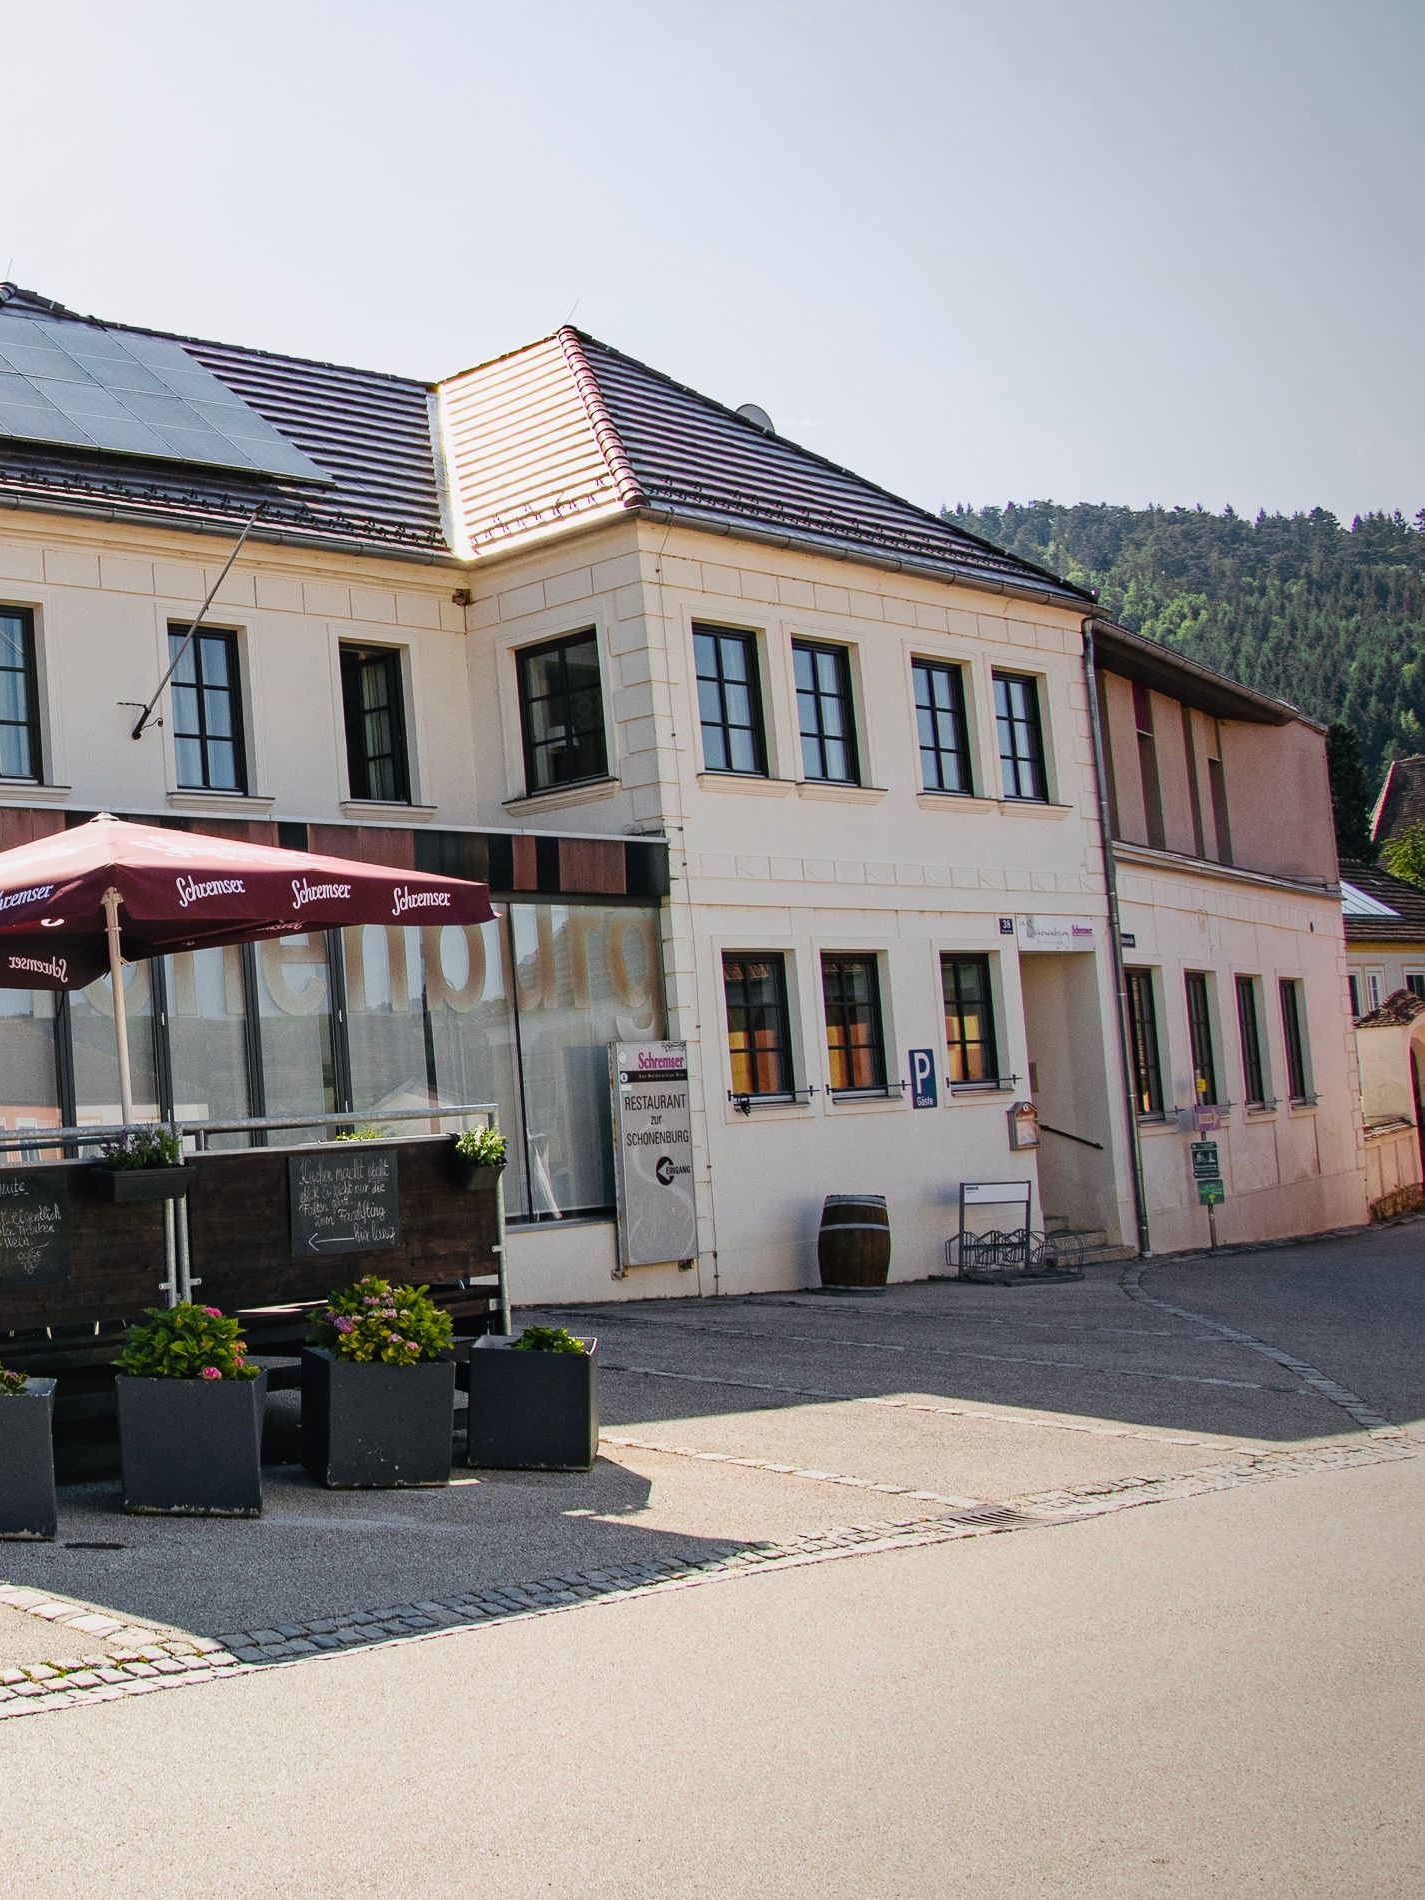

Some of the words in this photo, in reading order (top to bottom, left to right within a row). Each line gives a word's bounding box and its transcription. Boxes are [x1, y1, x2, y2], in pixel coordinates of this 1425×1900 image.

[175, 875, 246, 908] Schremser
[291, 877, 351, 910] Schremser
[391, 887, 451, 917] Schremser
[638, 1051, 684, 1069] Schremser
[914, 1052, 930, 1094] P
[624, 1093, 687, 1111] RESTAURANT
[650, 1115, 663, 1125] zur
[335, 1158, 365, 1181] macht
[665, 1165, 691, 1176] EINGANG
[355, 1183, 369, 1195] nur
[371, 1180, 386, 1194] die
[372, 1220, 396, 1245] lang
